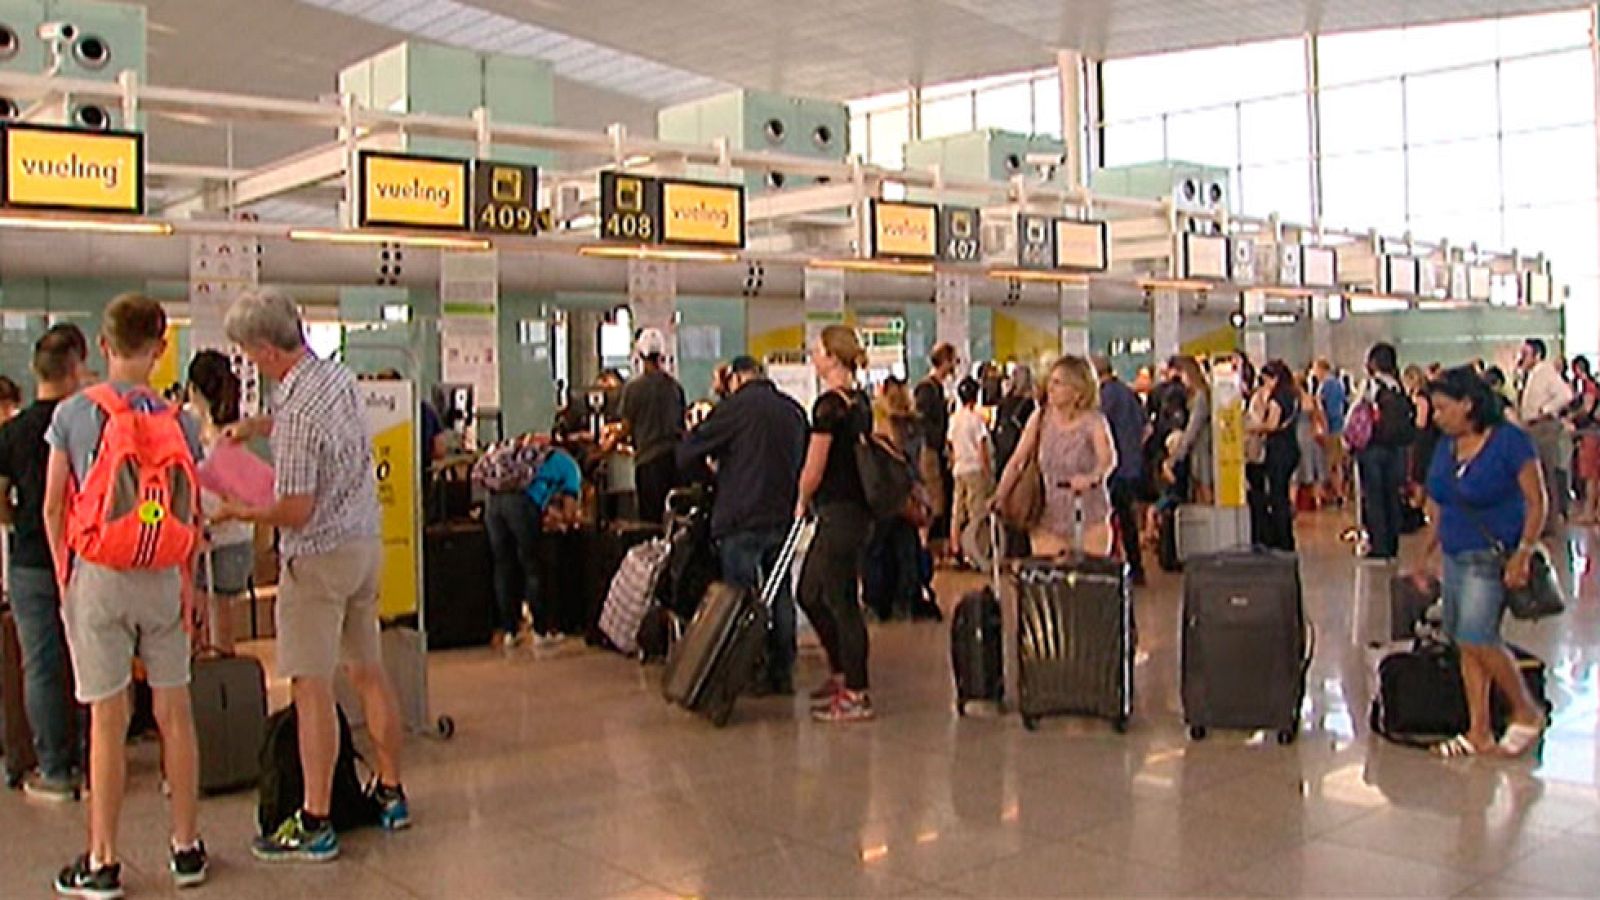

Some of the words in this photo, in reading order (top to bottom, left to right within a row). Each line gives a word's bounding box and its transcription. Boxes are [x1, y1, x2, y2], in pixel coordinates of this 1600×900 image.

[21, 152, 117, 189] vueling
[377, 177, 450, 208] vueling
[480, 203, 532, 231] 409
[607, 213, 652, 238] 408
[948, 239, 977, 259] 407
